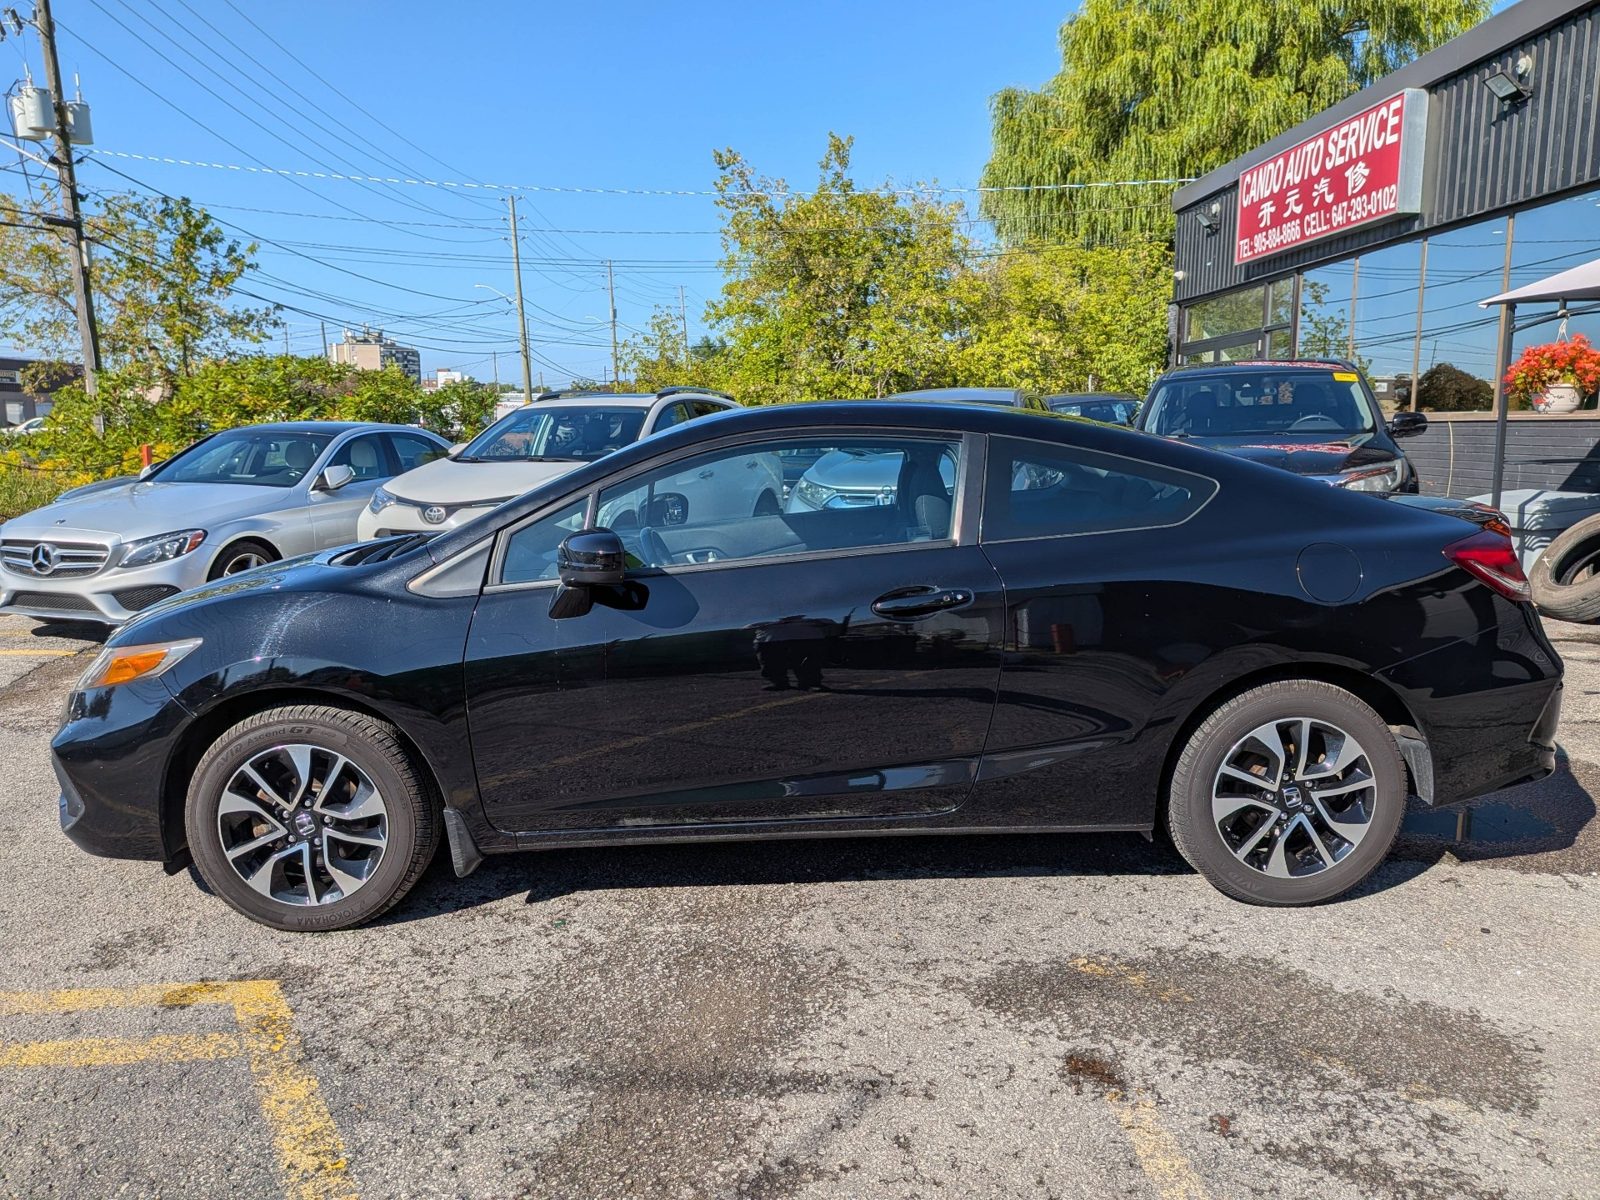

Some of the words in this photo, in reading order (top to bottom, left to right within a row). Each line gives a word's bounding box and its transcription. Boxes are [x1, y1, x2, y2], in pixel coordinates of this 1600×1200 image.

[1242, 157, 1284, 208] CANDO
[1283, 137, 1325, 189] AUTO
[1325, 98, 1402, 170] SERVICE
[1239, 236, 1253, 259] TEL:
[1253, 219, 1301, 253] 905-884-8666
[1303, 211, 1330, 236] CELL:
[1331, 184, 1397, 227] 647-293-0102
[1257, 161, 1370, 228] 开元汽修
[247, 728, 286, 745] Ascend
[288, 726, 319, 735] GT
[296, 908, 357, 926] YOKOHAMA
